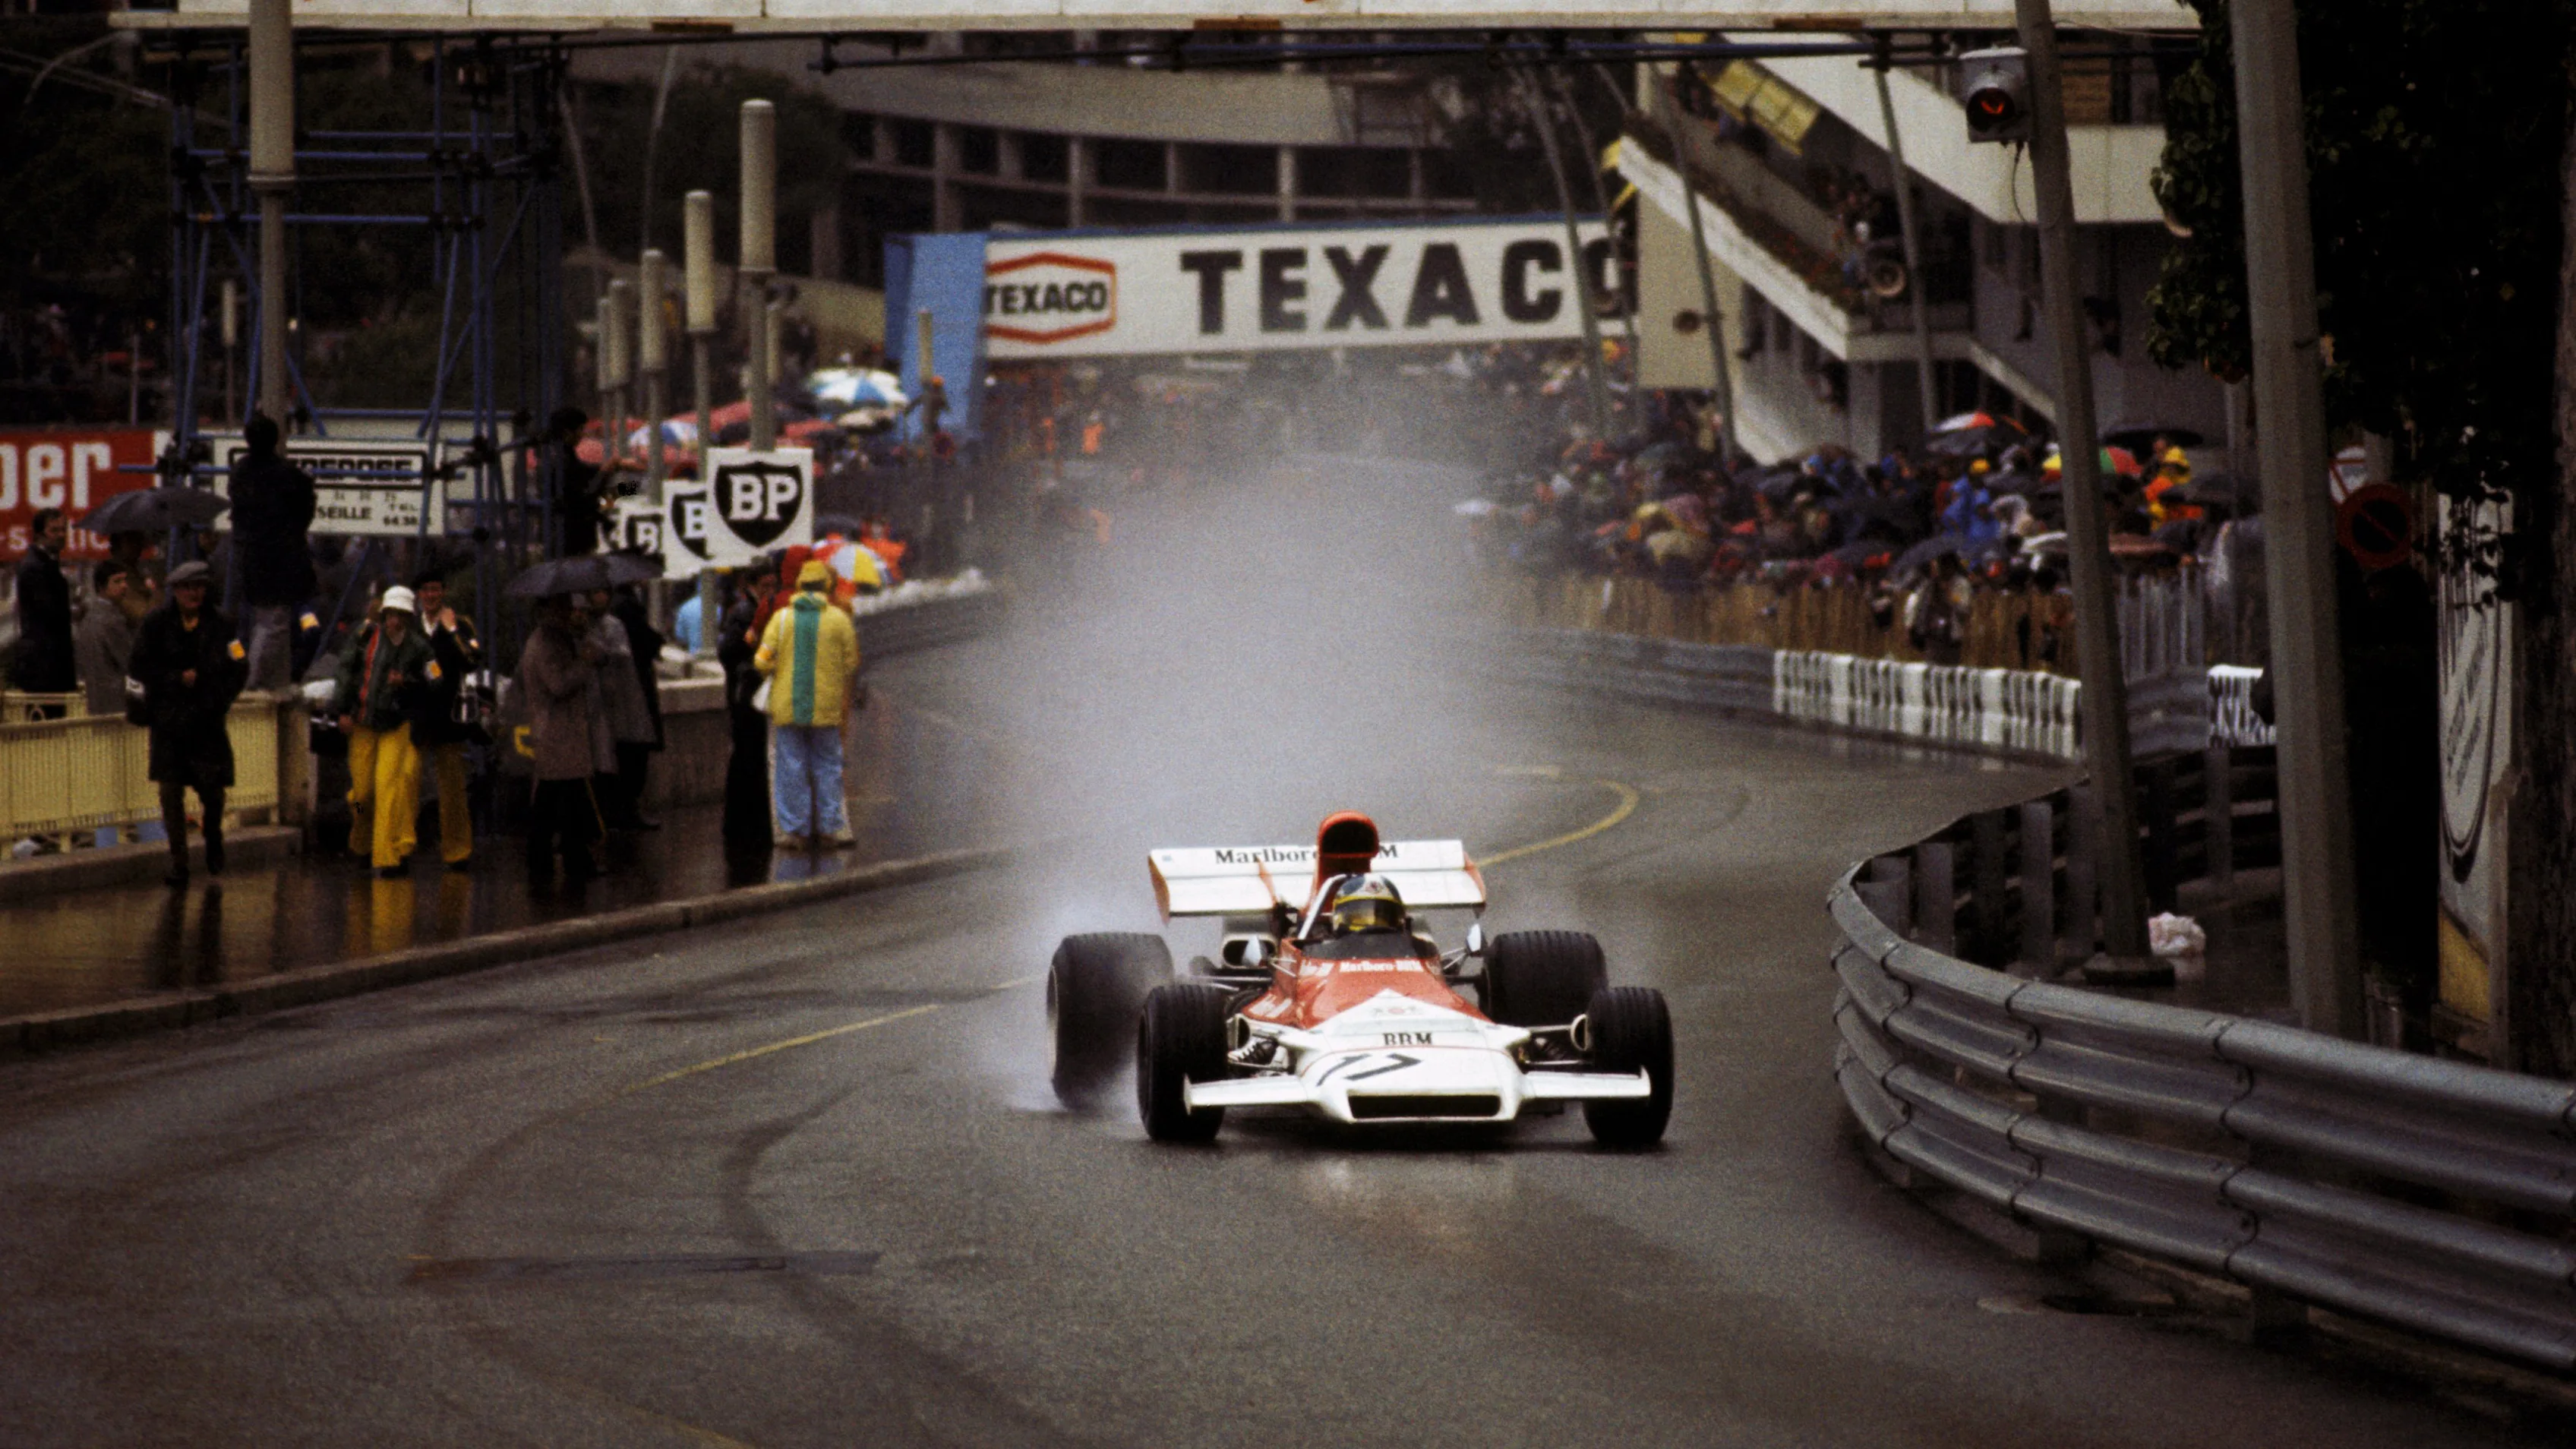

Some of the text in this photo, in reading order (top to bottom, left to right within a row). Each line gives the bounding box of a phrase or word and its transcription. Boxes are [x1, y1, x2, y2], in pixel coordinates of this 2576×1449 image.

[982, 282, 1107, 314] TEXACO
[317, 506, 371, 519] SEILLE
[728, 473, 798, 521] BP
[684, 500, 706, 538] B
[1315, 1052, 1423, 1087] 17
